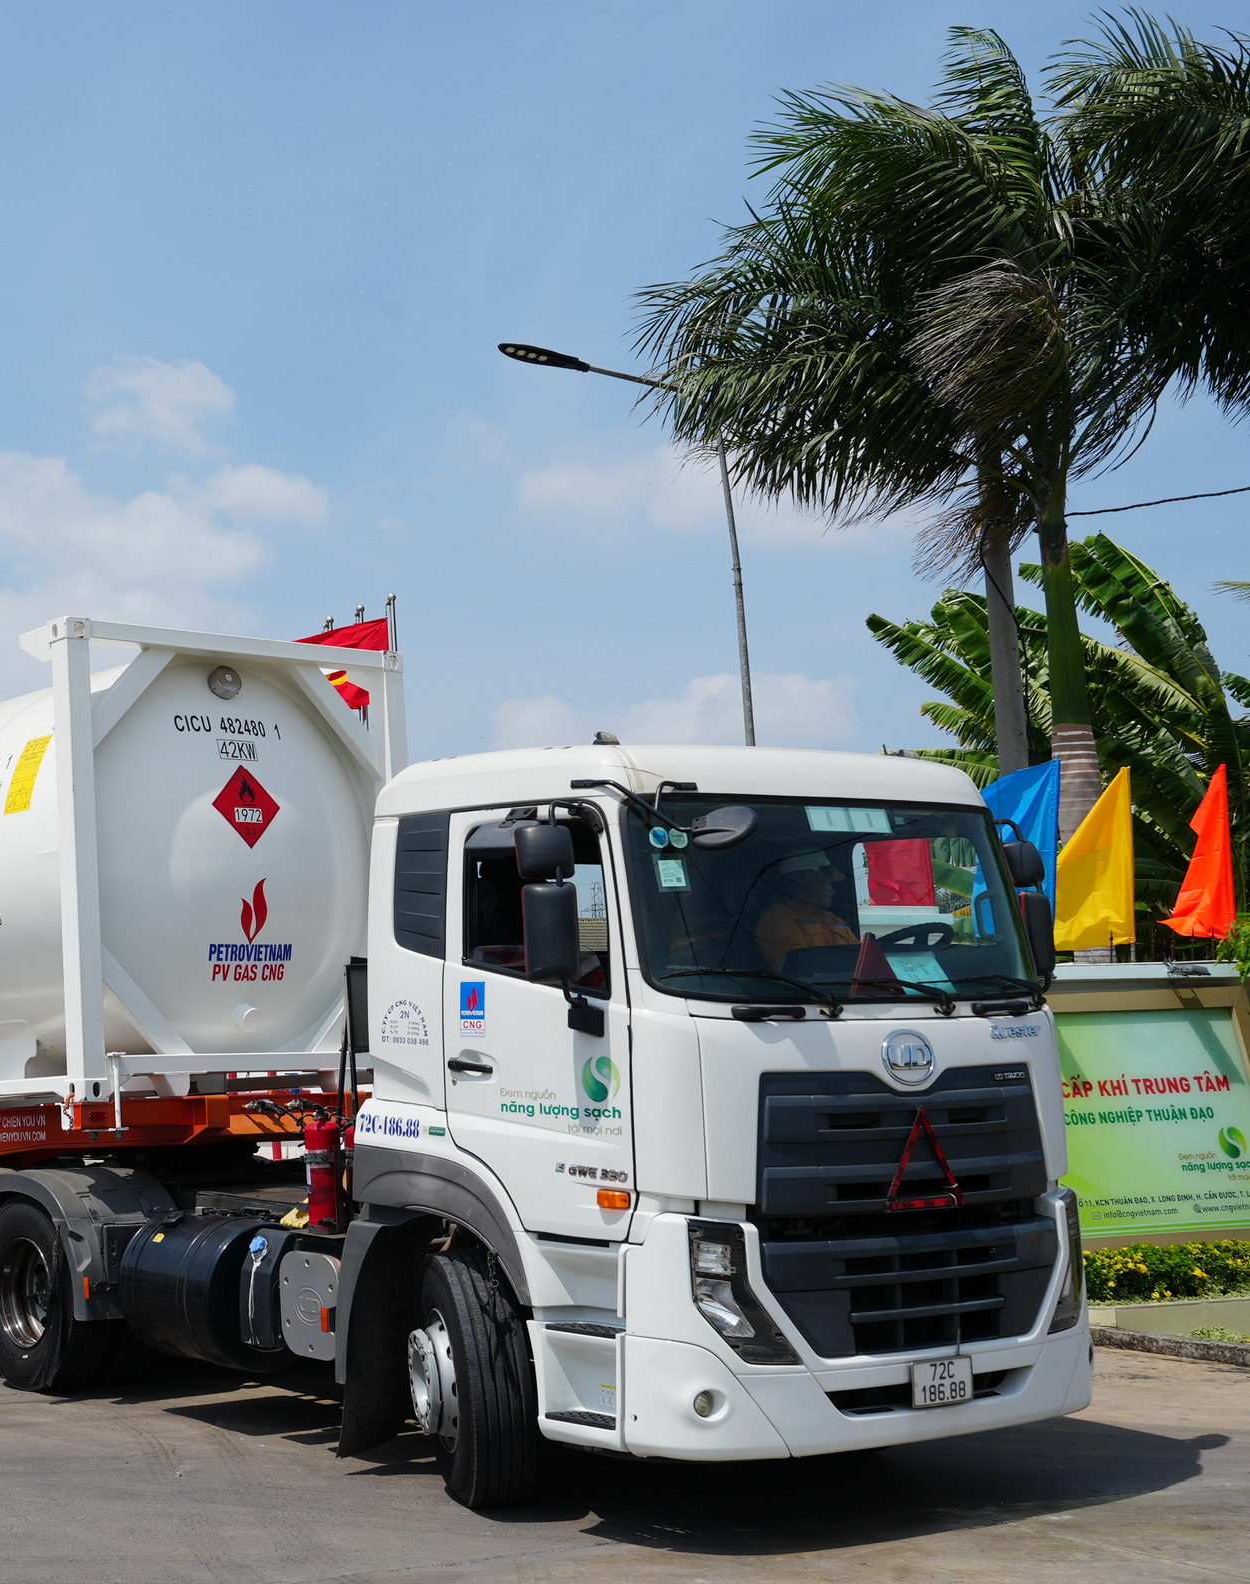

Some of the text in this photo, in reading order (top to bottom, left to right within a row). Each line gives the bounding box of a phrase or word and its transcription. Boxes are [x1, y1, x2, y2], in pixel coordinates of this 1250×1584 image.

[174, 715, 281, 740] CICU 482480 1
[220, 741, 256, 760] 42KW
[5, 754, 13, 769] 1
[235, 808, 262, 822] 1972
[208, 943, 292, 962] PETROVIETNAM
[212, 963, 284, 981] PV GAS CNG
[400, 1010, 409, 1019] 2N
[463, 1021, 482, 1029] CNG
[989, 1025, 1041, 1040] Quester
[393, 1036, 406, 1044] 0933
[887, 1045, 932, 1070] UD
[1061, 1070, 1231, 1098] CẤP KHÍ TRUNG TÂM
[500, 1088, 556, 1101] Đem nguồn
[501, 1101, 622, 1121] năng lượng sạch
[1065, 1104, 1214, 1126] CÔNG NGHIỆP THUẬN ĐẠO
[2, 1116, 21, 1128] CHIEN
[22, 1115, 35, 1127] YOU
[36, 1114, 46, 1126] VN
[360, 1113, 420, 1138] 72C-186.88
[567, 1123, 622, 1136] tới mọi nơi
[568, 1164, 598, 1180] GWE
[1181, 1162, 1205, 1173] năng
[1207, 1161, 1234, 1172] lượng
[1096, 1199, 1110, 1207] KCN
[1110, 1196, 1133, 1206] THUẬN
[1159, 1194, 1176, 1203] LONG
[1103, 1208, 1178, 1219] info@cngvietnam.com
[930, 1361, 955, 1381] 72C
[922, 1380, 966, 1403] 186.88
